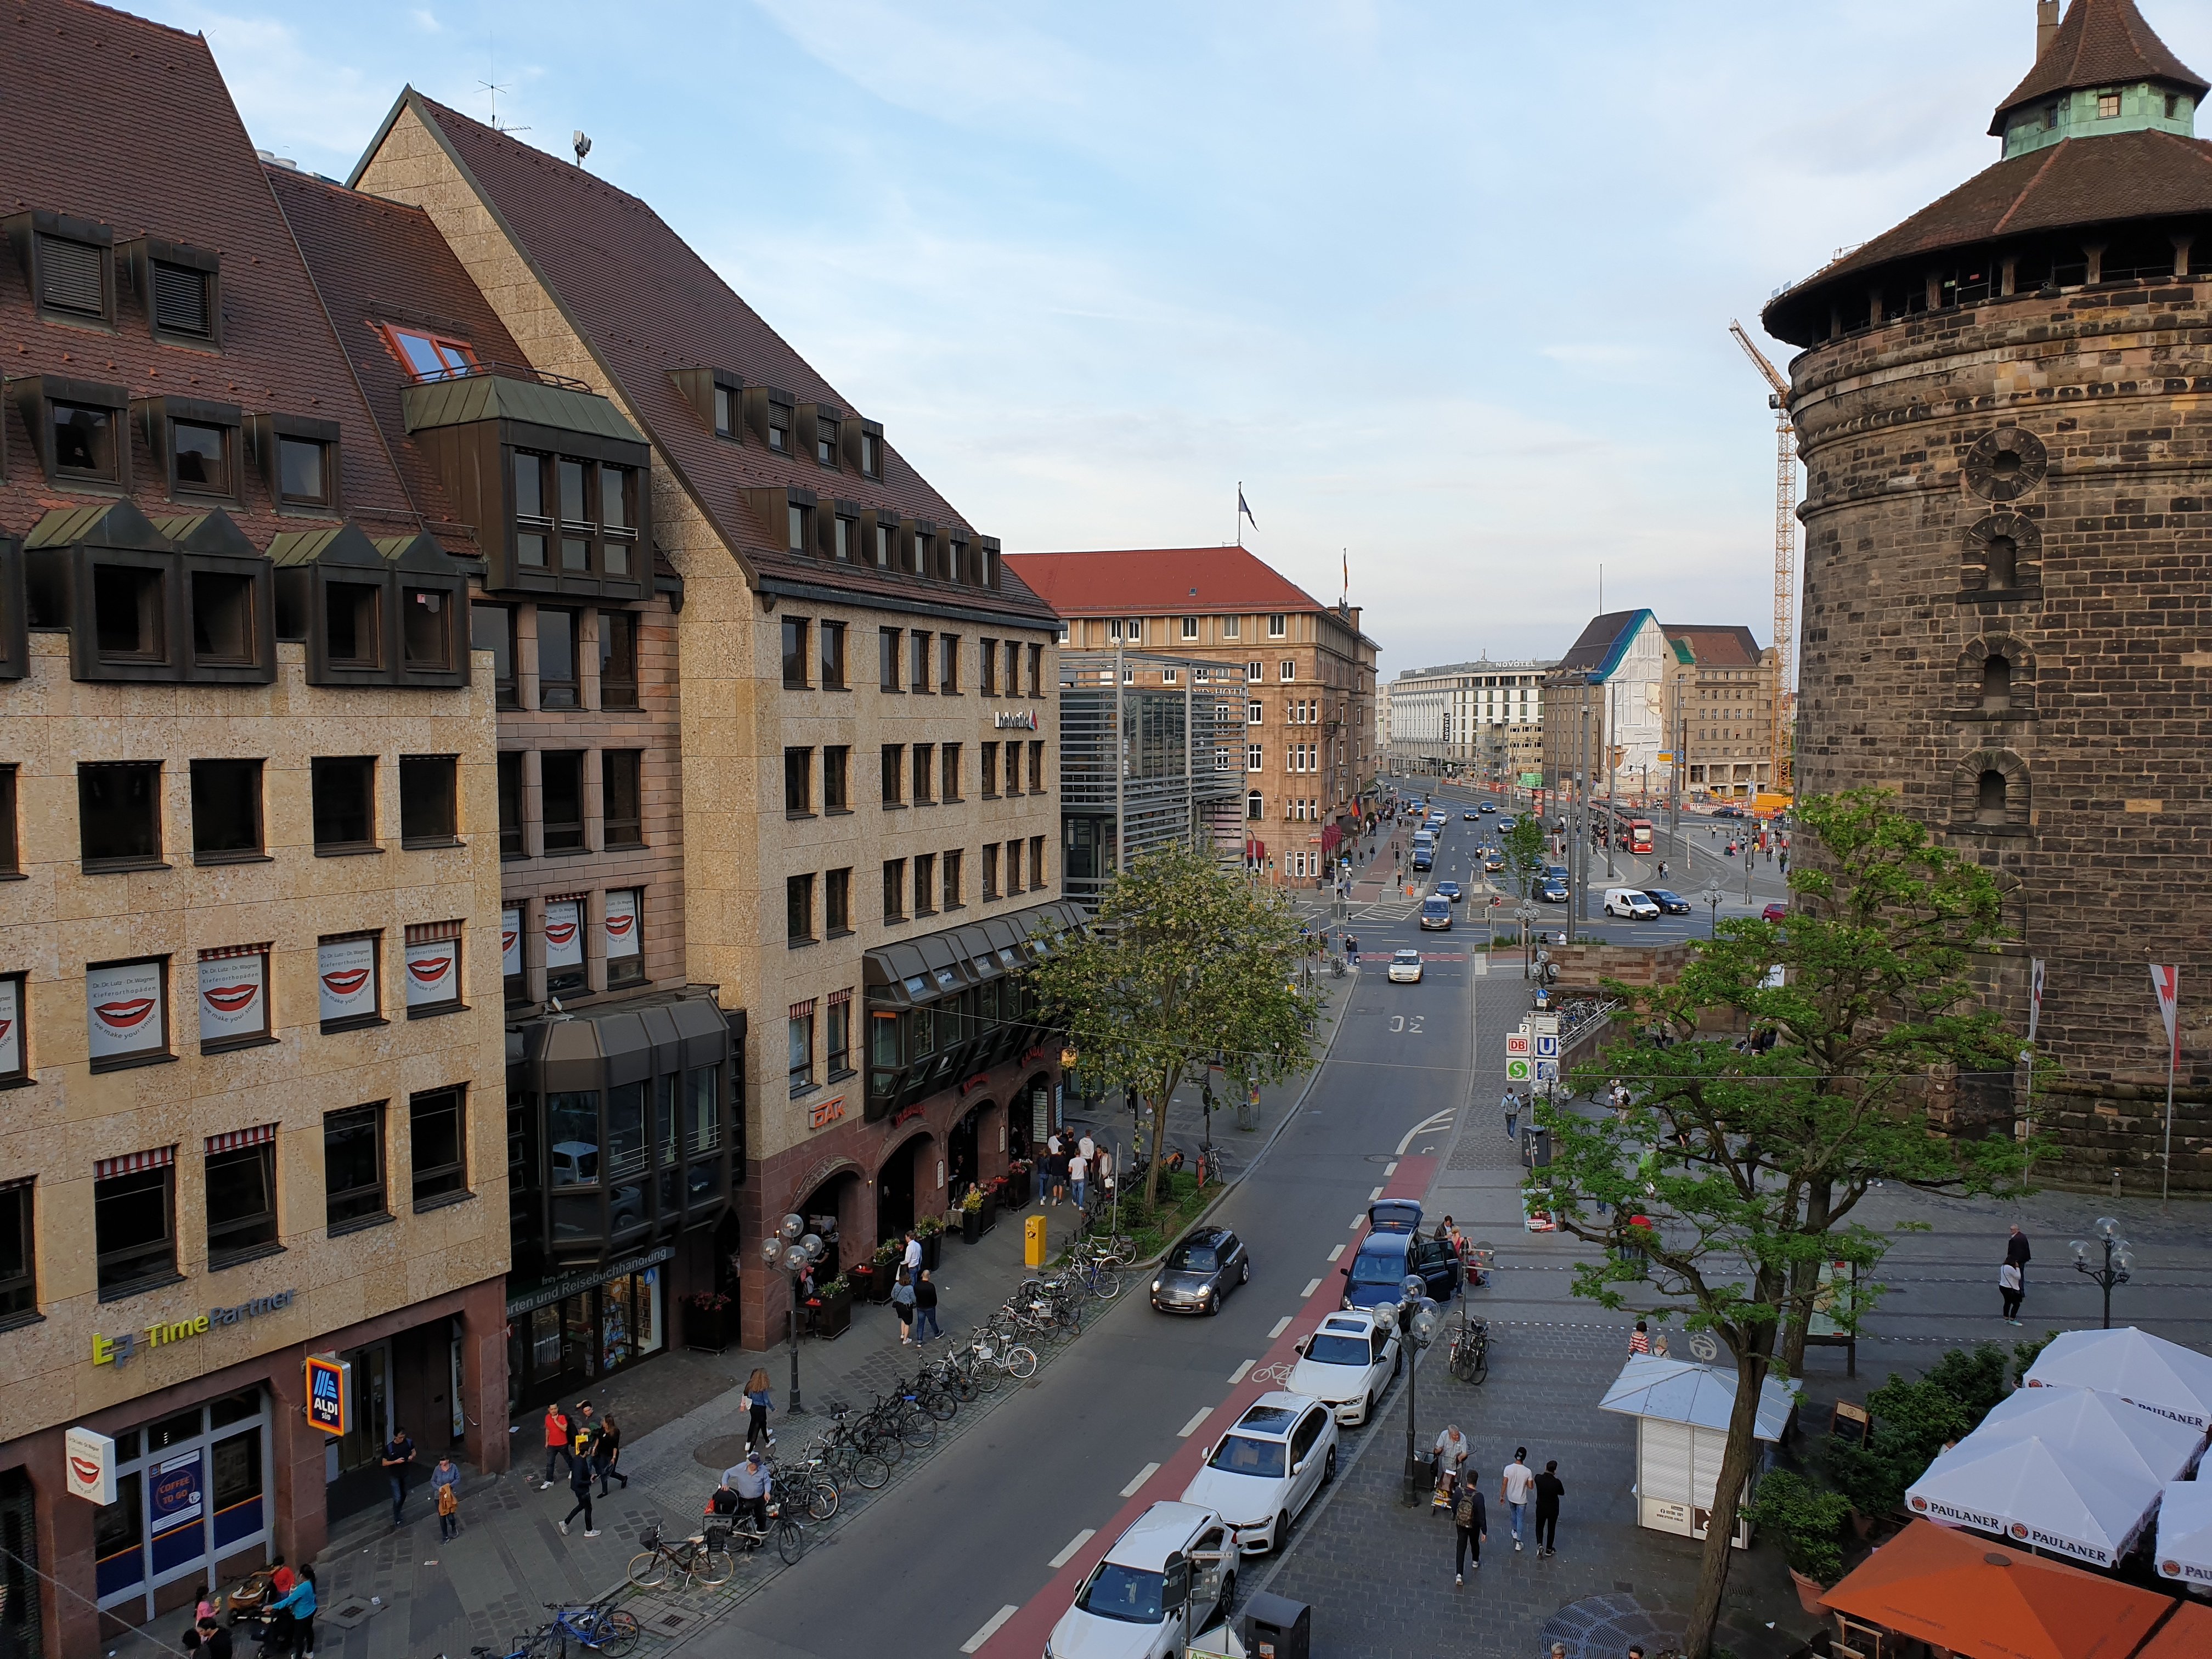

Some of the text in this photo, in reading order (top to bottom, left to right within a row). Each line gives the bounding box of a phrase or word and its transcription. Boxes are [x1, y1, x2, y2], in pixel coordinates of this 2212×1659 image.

[995, 712, 1030, 727] helvetia
[407, 947, 453, 957] Kieferorthopäden
[508, 943, 518, 956] smile
[548, 944, 560, 952] make
[320, 958, 370, 968] Kieferorthopäden
[202, 973, 259, 984] Kieferorthopäden
[408, 970, 452, 992] we make your smile
[93, 986, 156, 998] Kieferorthopäden
[321, 982, 371, 1006] we make your smile
[204, 998, 259, 1023] we make your smile
[94, 1013, 157, 1040] we make your smile
[1511, 1040, 1526, 1050] DB
[1539, 1038, 1555, 1054] U
[1513, 1063, 1523, 1077] S
[810, 1096, 847, 1128] DAK
[506, 1298, 533, 1316] arten
[537, 1286, 558, 1305] und
[144, 1289, 296, 1348] TimePartner
[314, 1397, 338, 1415] ALDI
[321, 1412, 331, 1421] SÜD
[159, 1476, 190, 1494] COFFEE
[163, 1489, 188, 1505] TO GO
[1931, 1502, 2000, 1530] PAULANER
[2032, 1530, 2107, 1563] PAULANER
